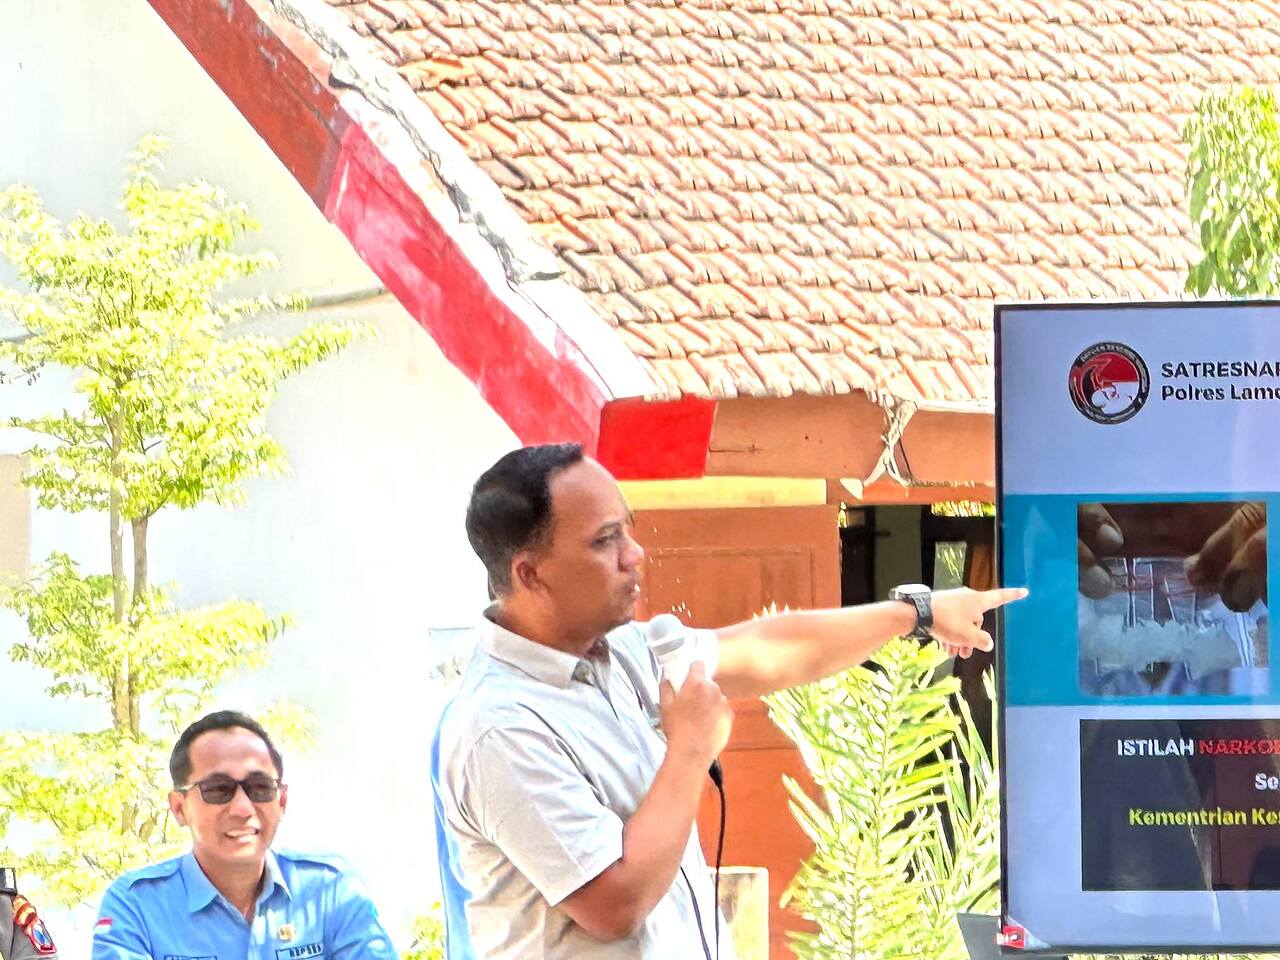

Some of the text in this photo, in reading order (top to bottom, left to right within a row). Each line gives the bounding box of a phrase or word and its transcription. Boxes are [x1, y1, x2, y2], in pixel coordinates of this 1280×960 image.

[1161, 383, 1225, 401] Polres
[1117, 738, 1195, 756] ISTILAH
[1129, 807, 1247, 826] Kementrian
